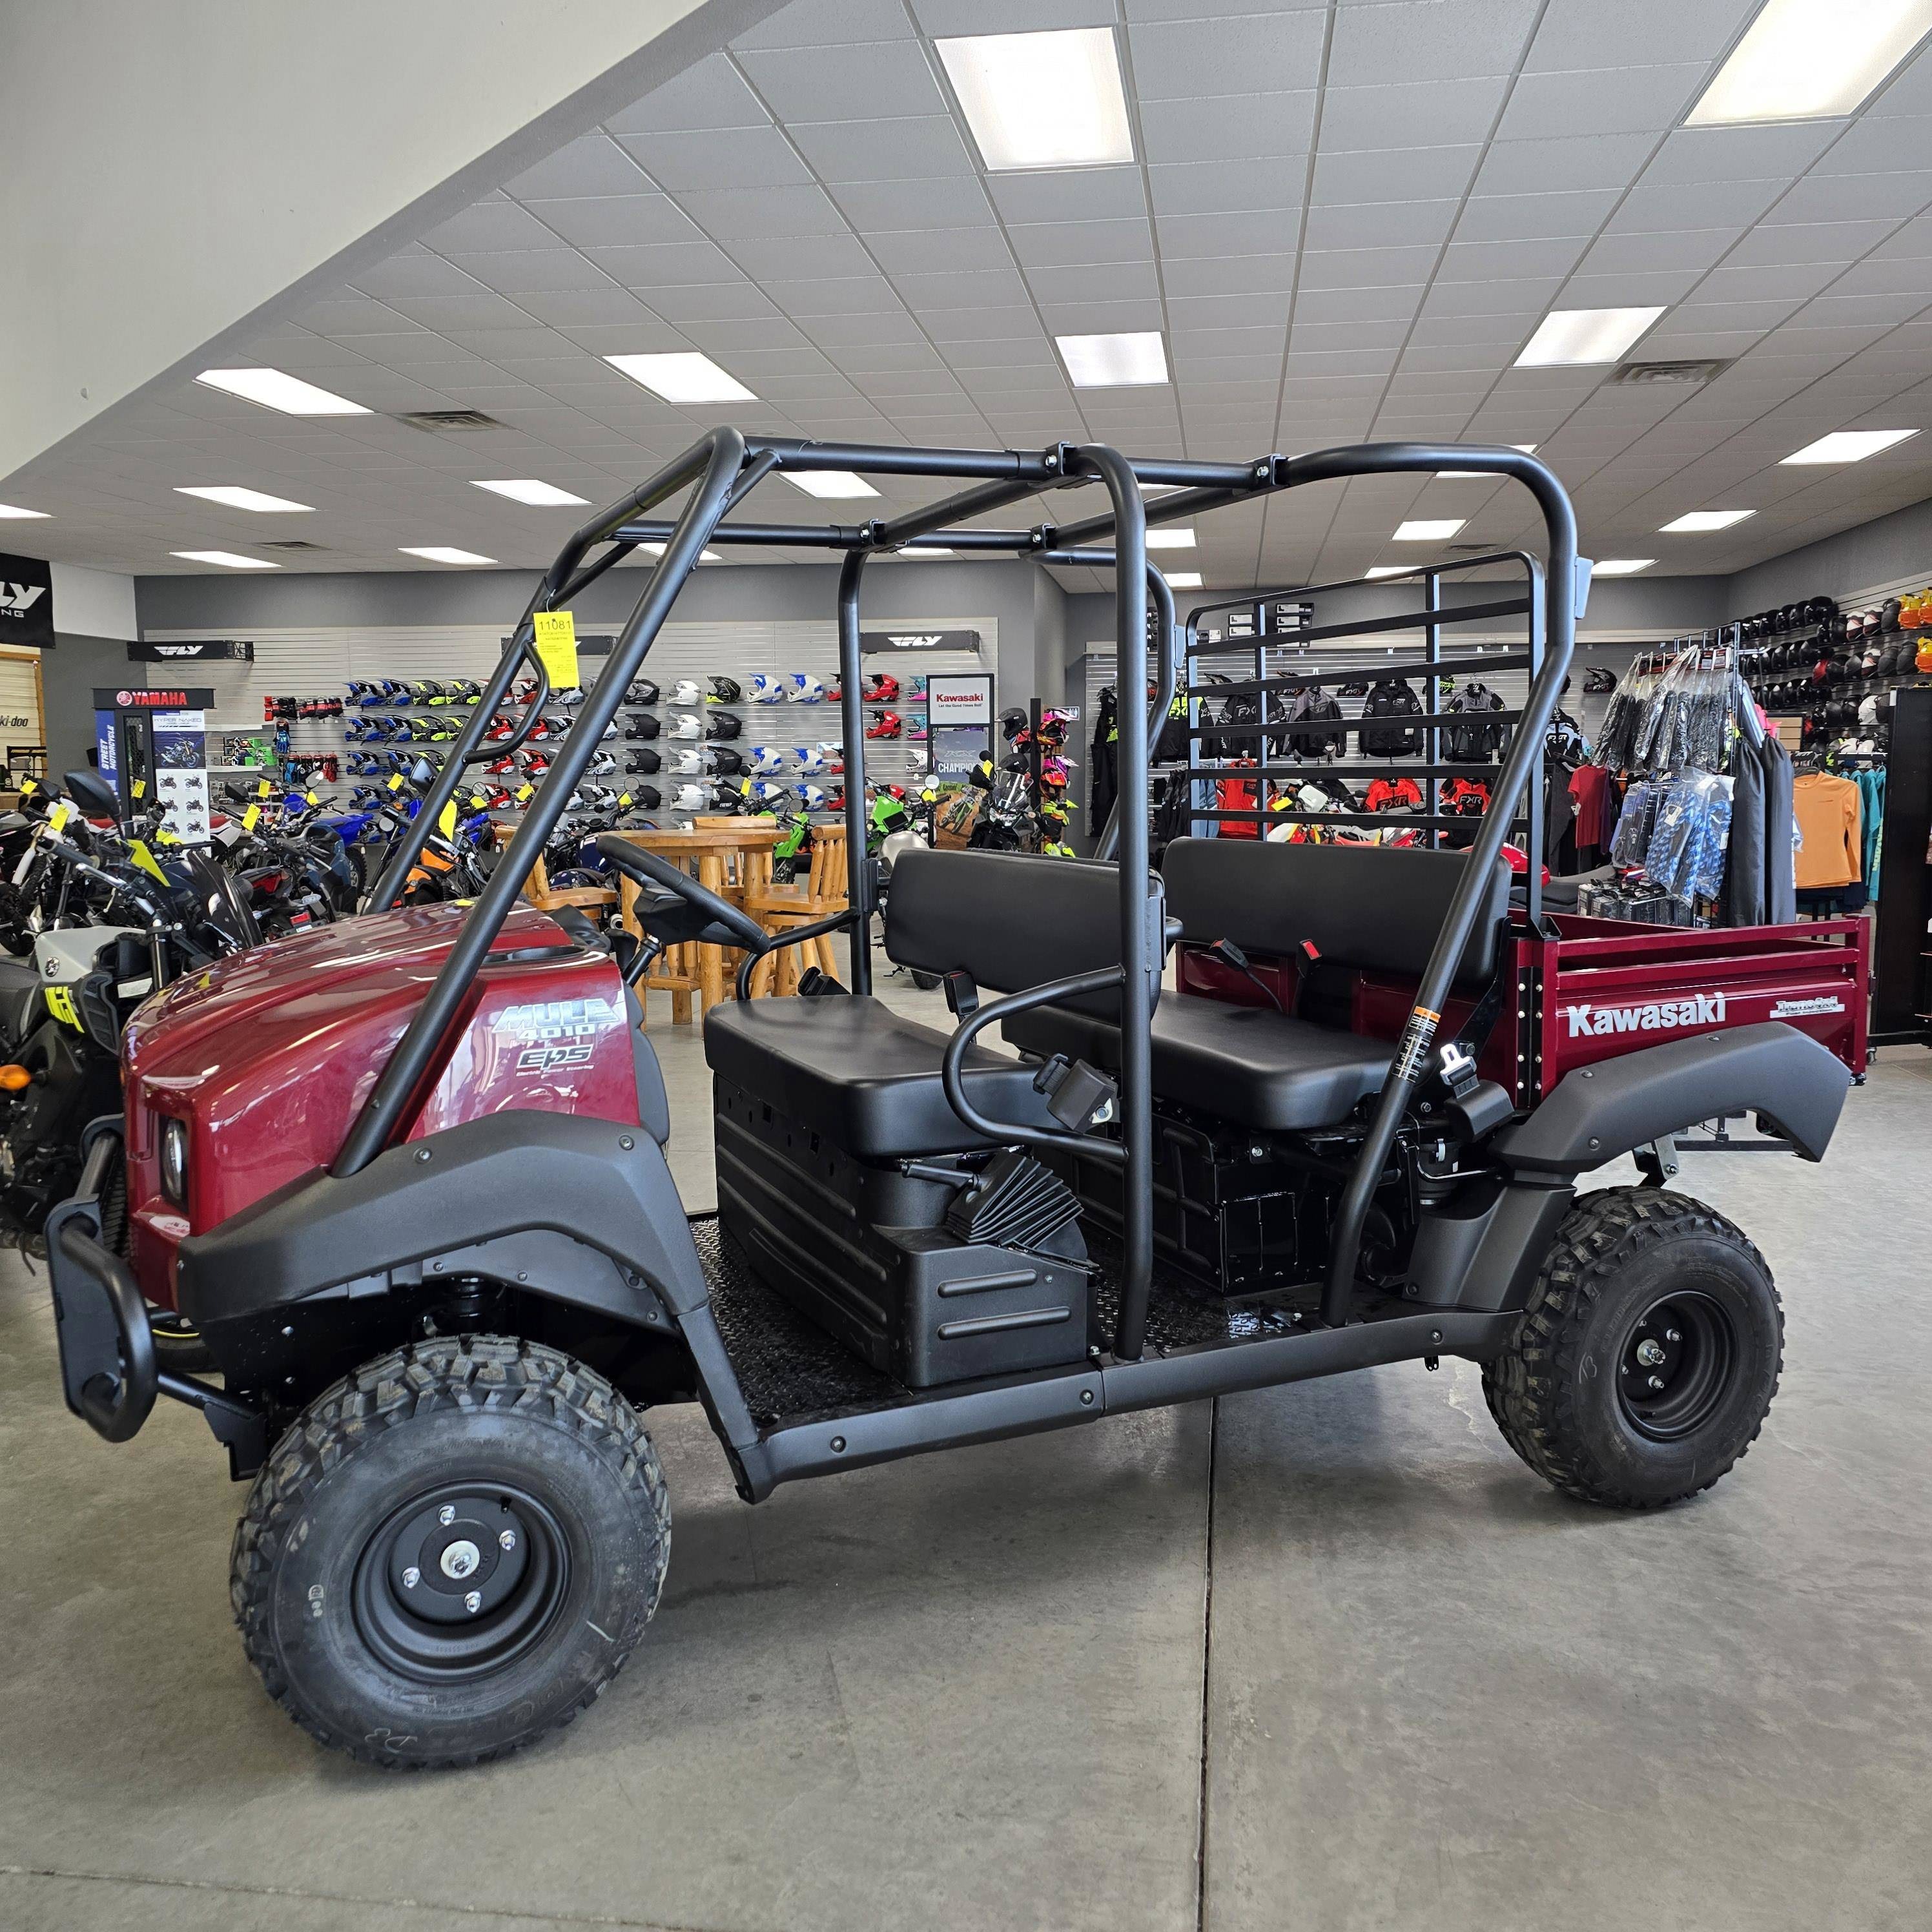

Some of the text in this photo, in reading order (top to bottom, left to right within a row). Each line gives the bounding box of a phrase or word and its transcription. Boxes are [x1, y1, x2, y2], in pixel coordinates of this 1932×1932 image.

[539, 621, 571, 630] 11081
[132, 692, 187, 705] YAMAHA
[936, 694, 983, 702] Kawasaki
[99, 738, 110, 770] STREET
[107, 724, 118, 770] MOTORCYCLE
[1459, 796, 1483, 805] FXR
[491, 998, 621, 1033] MULE
[1566, 991, 1726, 1038] Kawasaki
[519, 1023, 595, 1040] 4010
